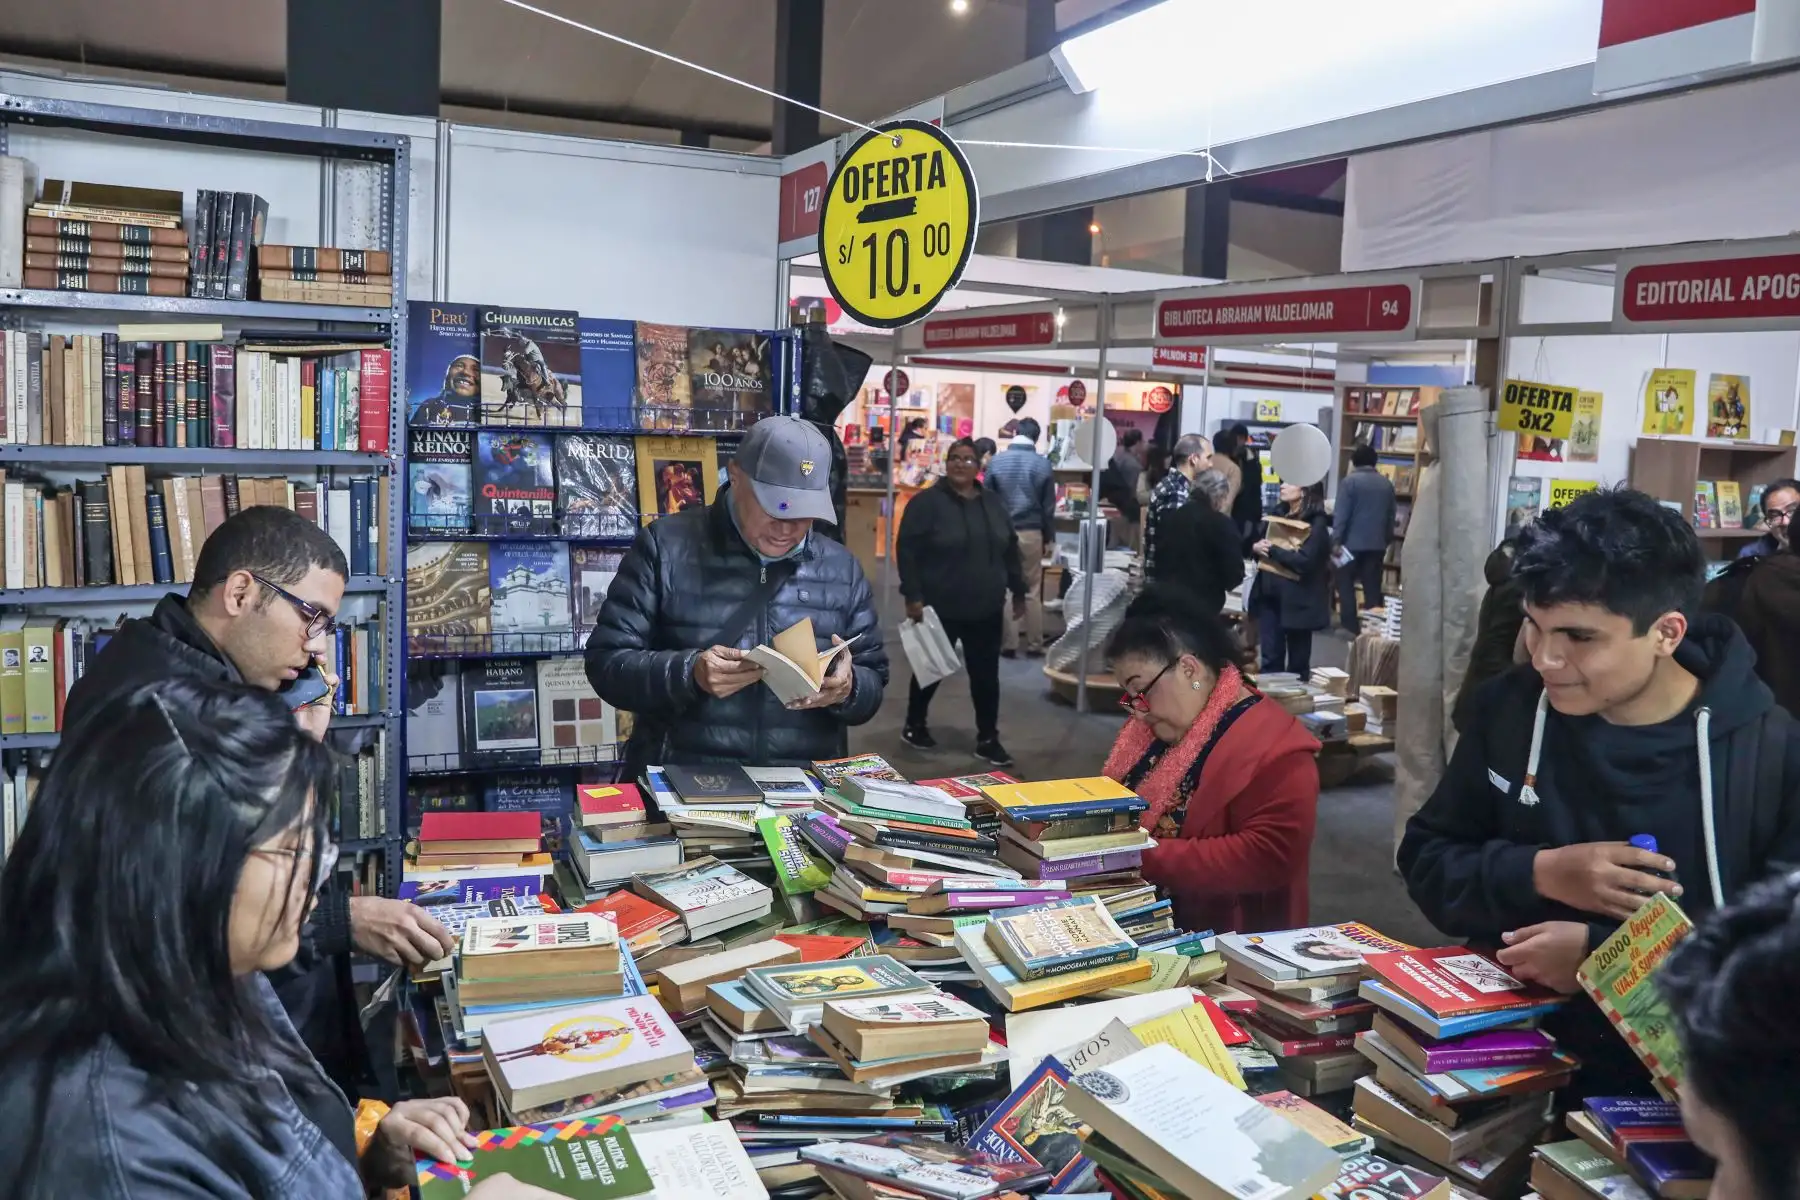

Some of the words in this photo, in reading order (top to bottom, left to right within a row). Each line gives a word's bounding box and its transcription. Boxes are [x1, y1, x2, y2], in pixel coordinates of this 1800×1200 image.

[843, 150, 946, 203] OFERTA
[803, 186, 820, 213] 127
[923, 222, 950, 257] 00
[1635, 277, 1735, 306] EDITORIAL
[430, 308, 468, 325] PERÚ
[485, 311, 575, 327] CHUMBIVILCAS
[1164, 309, 1213, 327] BIBLIOTECA
[1215, 306, 1262, 325] ABRAHAM
[1264, 301, 1334, 322] VALDELOMAR
[1381, 300, 1399, 316] 94
[926, 327, 953, 340] BIBLIOTECA
[980, 323, 1017, 338] VALDELOMAR
[1039, 323, 1049, 334] 94
[121, 375, 129, 411] PIEROLA
[703, 373, 733, 387] 100
[735, 375, 763, 389] AÑOS
[1504, 384, 1572, 413] OFERTA
[1518, 409, 1554, 433] 3x2
[482, 484, 555, 500] Quintanilla
[486, 669, 523, 677] HABANO
[544, 680, 571, 688] QUINUA
[512, 786, 560, 796] Creación
[781, 826, 808, 870] FORMERS
[779, 849, 800, 880] TRANS
[1045, 863, 1060, 873] SUSAN
[1060, 861, 1080, 871] ELIZABETH
[1061, 918, 1083, 943] SOPHIE
[1067, 914, 1091, 943] HANNAH
[1595, 934, 1631, 970] 20000
[1629, 901, 1666, 938] leguas
[1051, 961, 1088, 973] MONOGRAM
[1088, 955, 1114, 966] MURDERS
[1629, 944, 1642, 963] de
[1614, 968, 1641, 996] VIAJE
[585, 1139, 617, 1186] AMBIENTALES
[603, 1135, 628, 1171] POLÍTICAS
[576, 1162, 597, 1181] PERÚ
